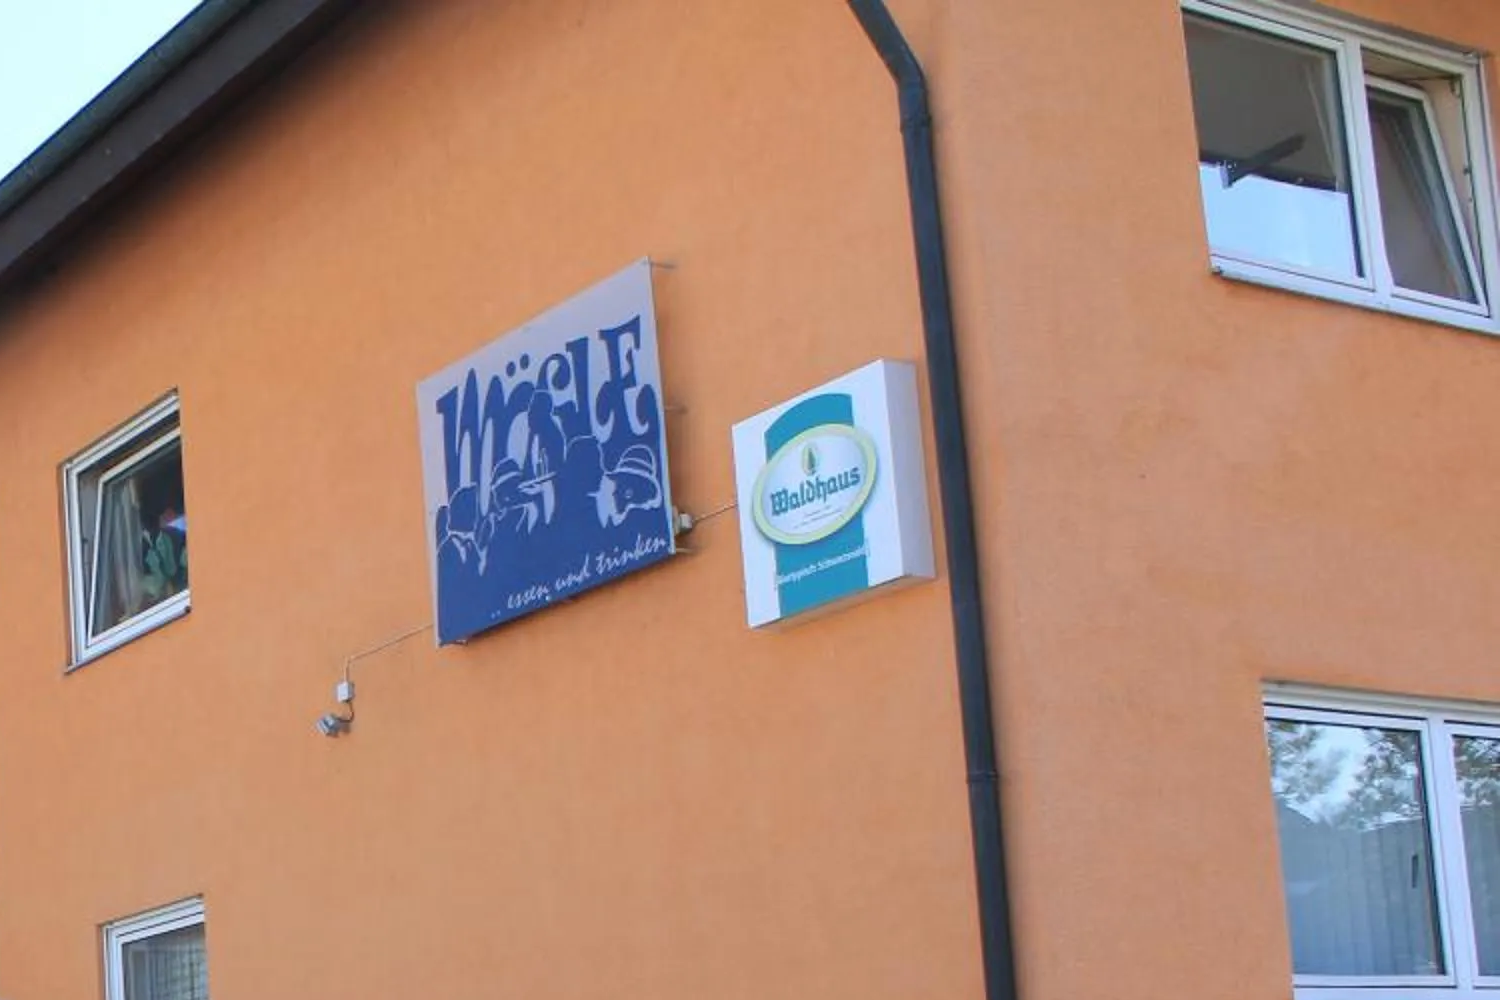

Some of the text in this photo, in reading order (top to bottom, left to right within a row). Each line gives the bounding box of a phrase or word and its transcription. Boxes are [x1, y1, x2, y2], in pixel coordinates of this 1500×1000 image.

[770, 466, 861, 517] Waldhaus
[507, 532, 667, 608] essen und trinken
